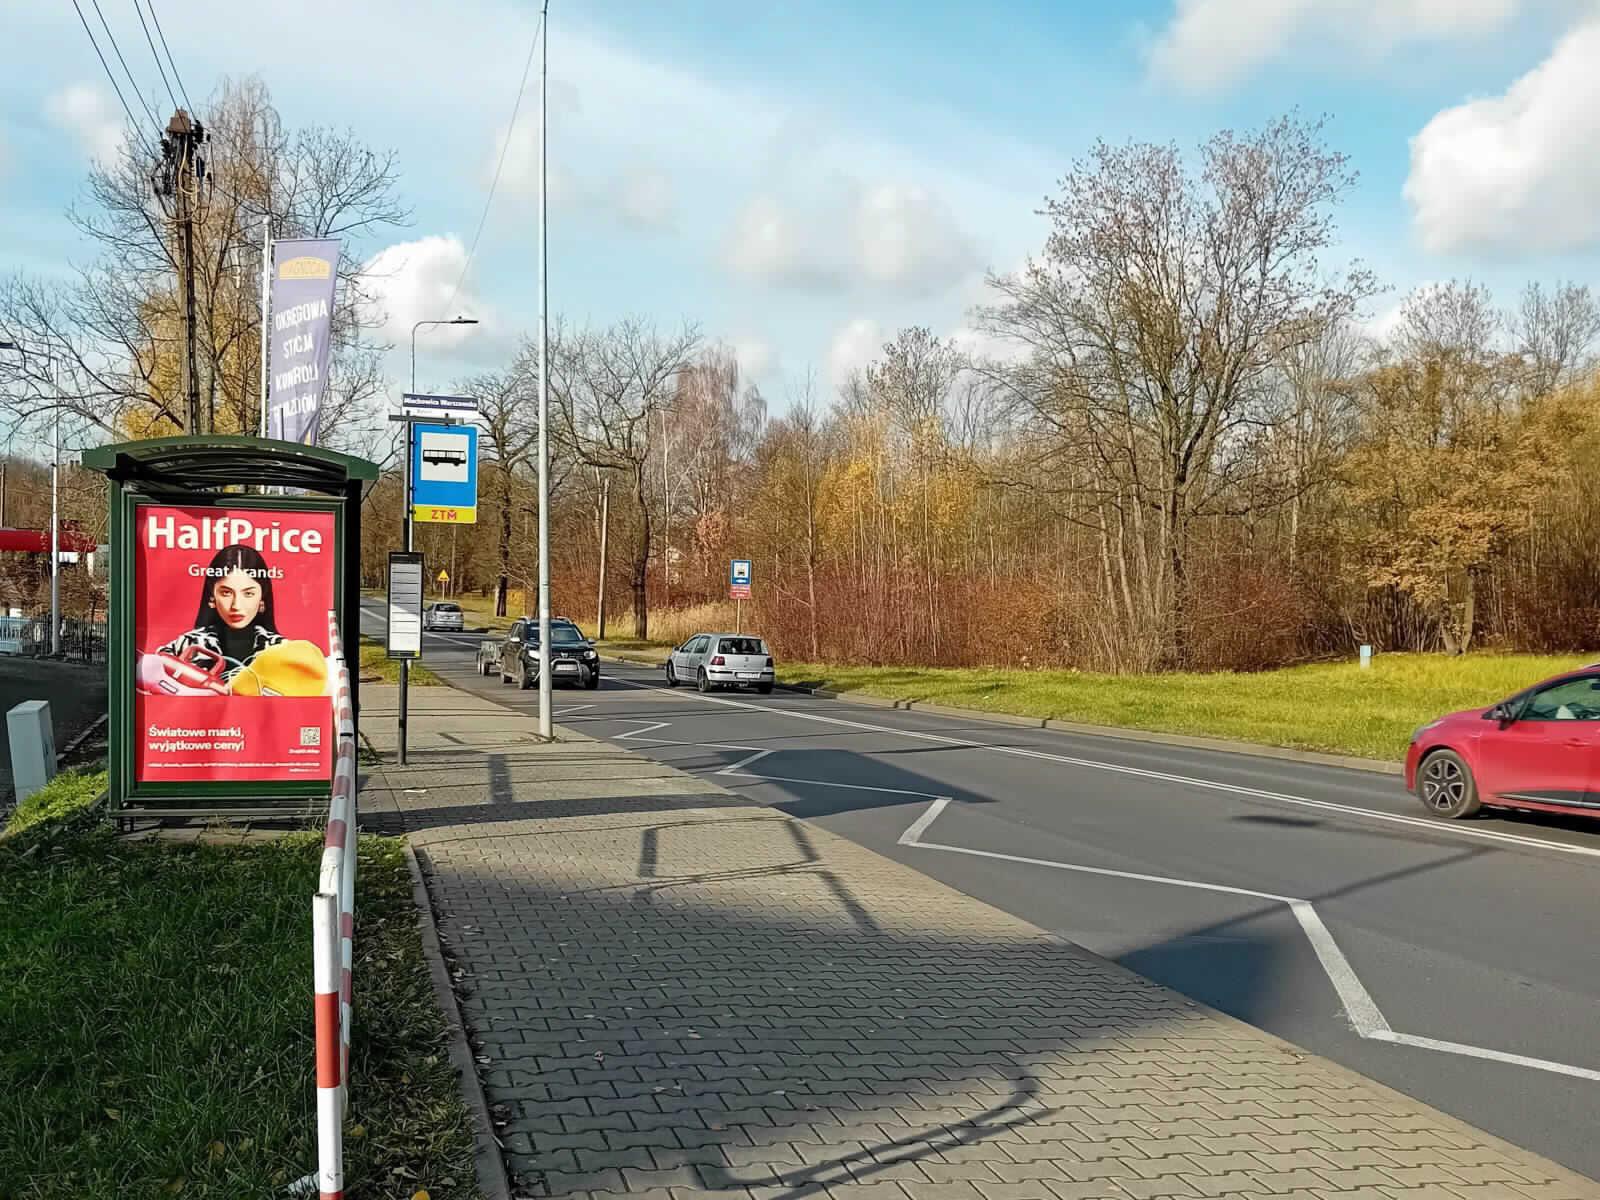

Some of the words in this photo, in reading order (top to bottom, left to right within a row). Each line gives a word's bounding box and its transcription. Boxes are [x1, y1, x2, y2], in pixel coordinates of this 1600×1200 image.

[431, 509, 457, 521] ZTM
[148, 516, 322, 553] HalfPrice
[188, 564, 230, 577] Great
[148, 724, 206, 738] Światowe
[207, 726, 245, 739] marki,
[148, 739, 212, 752] wyjątkowe
[213, 740, 245, 752] ceny!
